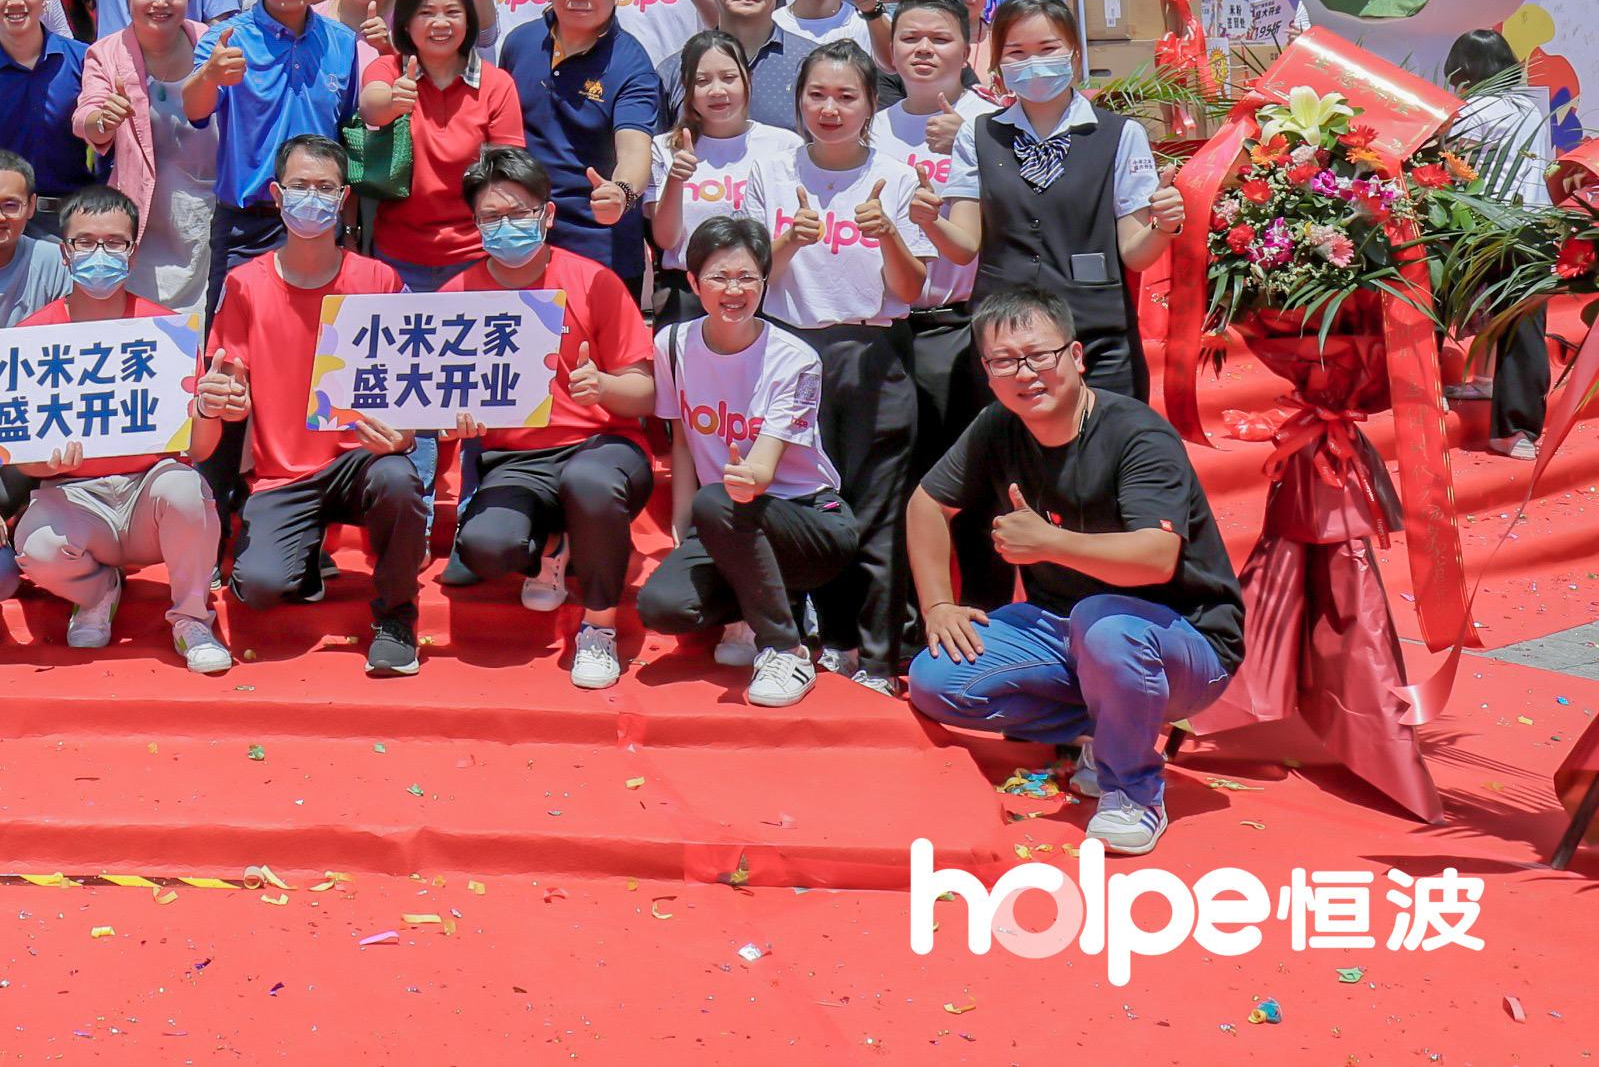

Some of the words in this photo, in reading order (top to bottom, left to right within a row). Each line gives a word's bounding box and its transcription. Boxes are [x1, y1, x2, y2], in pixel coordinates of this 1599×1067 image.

[352, 312, 522, 360] 小米之家
[350, 362, 520, 410] 盛大开业
